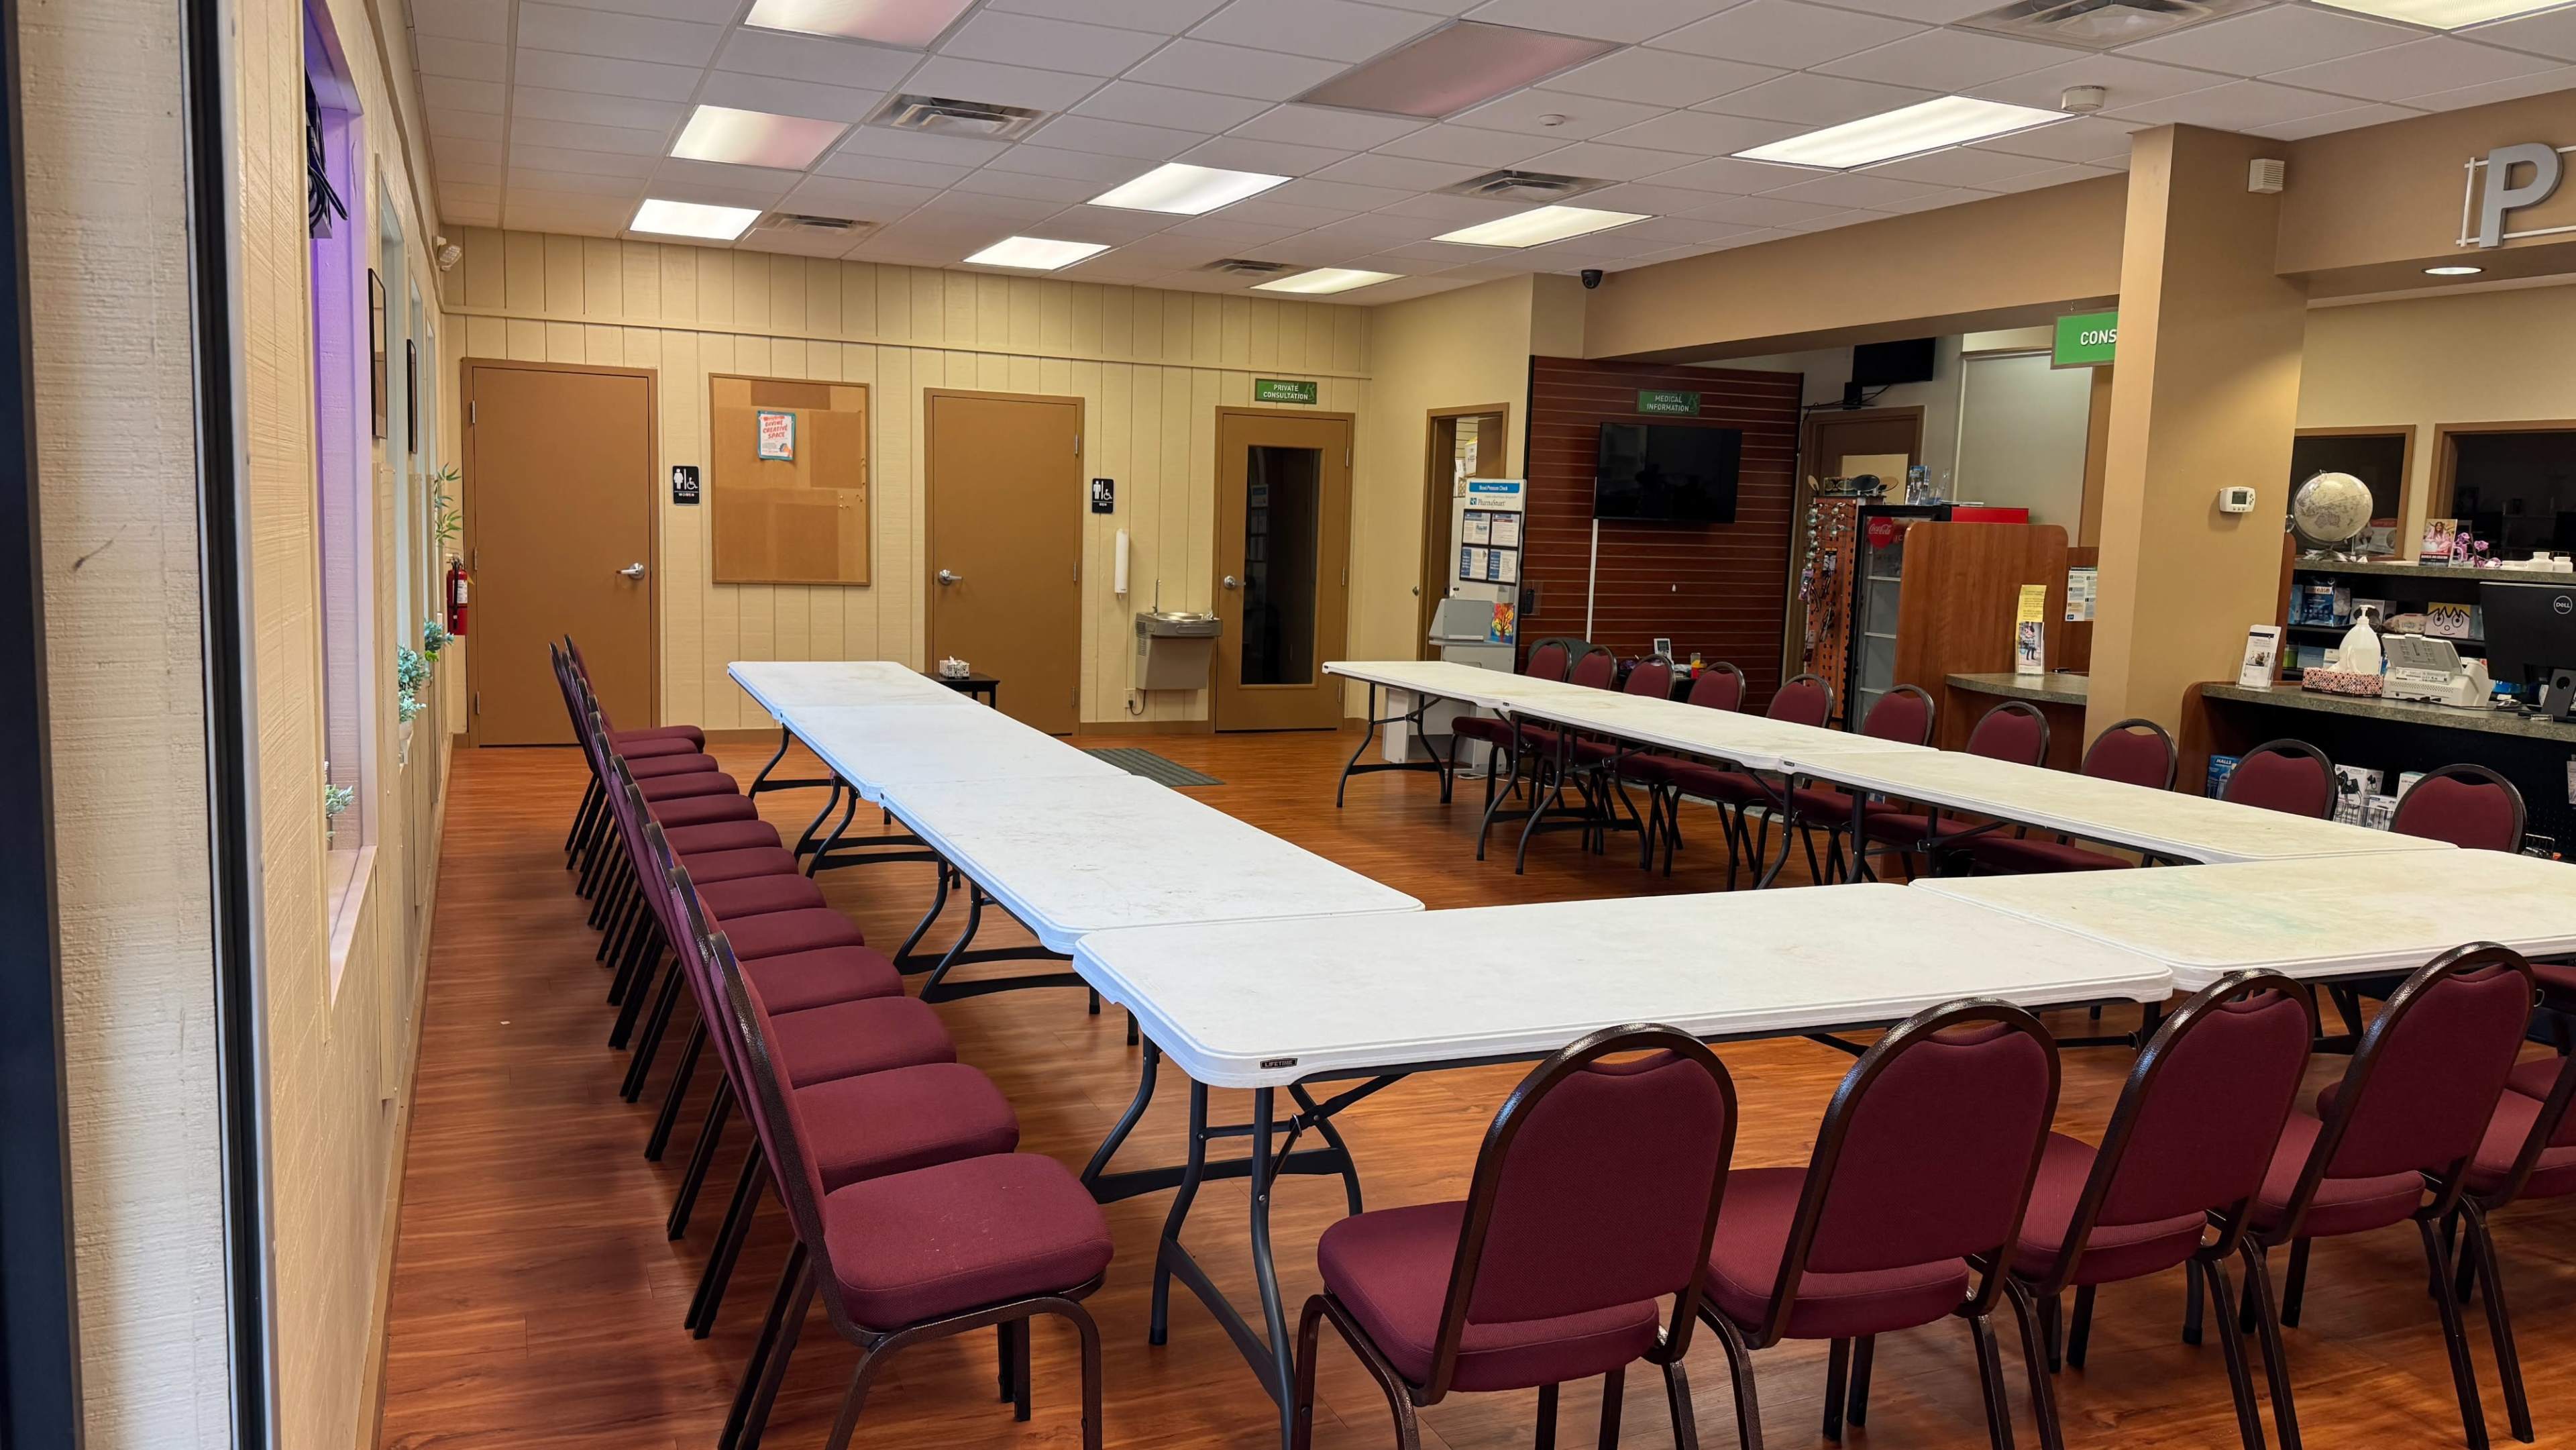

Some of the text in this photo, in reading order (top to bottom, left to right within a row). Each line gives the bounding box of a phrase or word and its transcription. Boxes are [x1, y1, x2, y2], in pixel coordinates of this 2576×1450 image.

[2479, 142, 2563, 248] P
[2080, 329, 2117, 346] CONS
[1273, 384, 1299, 392] PRIVATE
[1263, 391, 1308, 401] CONSULTATION
[1655, 395, 1682, 403] MEDICAL
[1647, 403, 1690, 412] INFORMATION
[763, 424, 788, 433] CREATIVE
